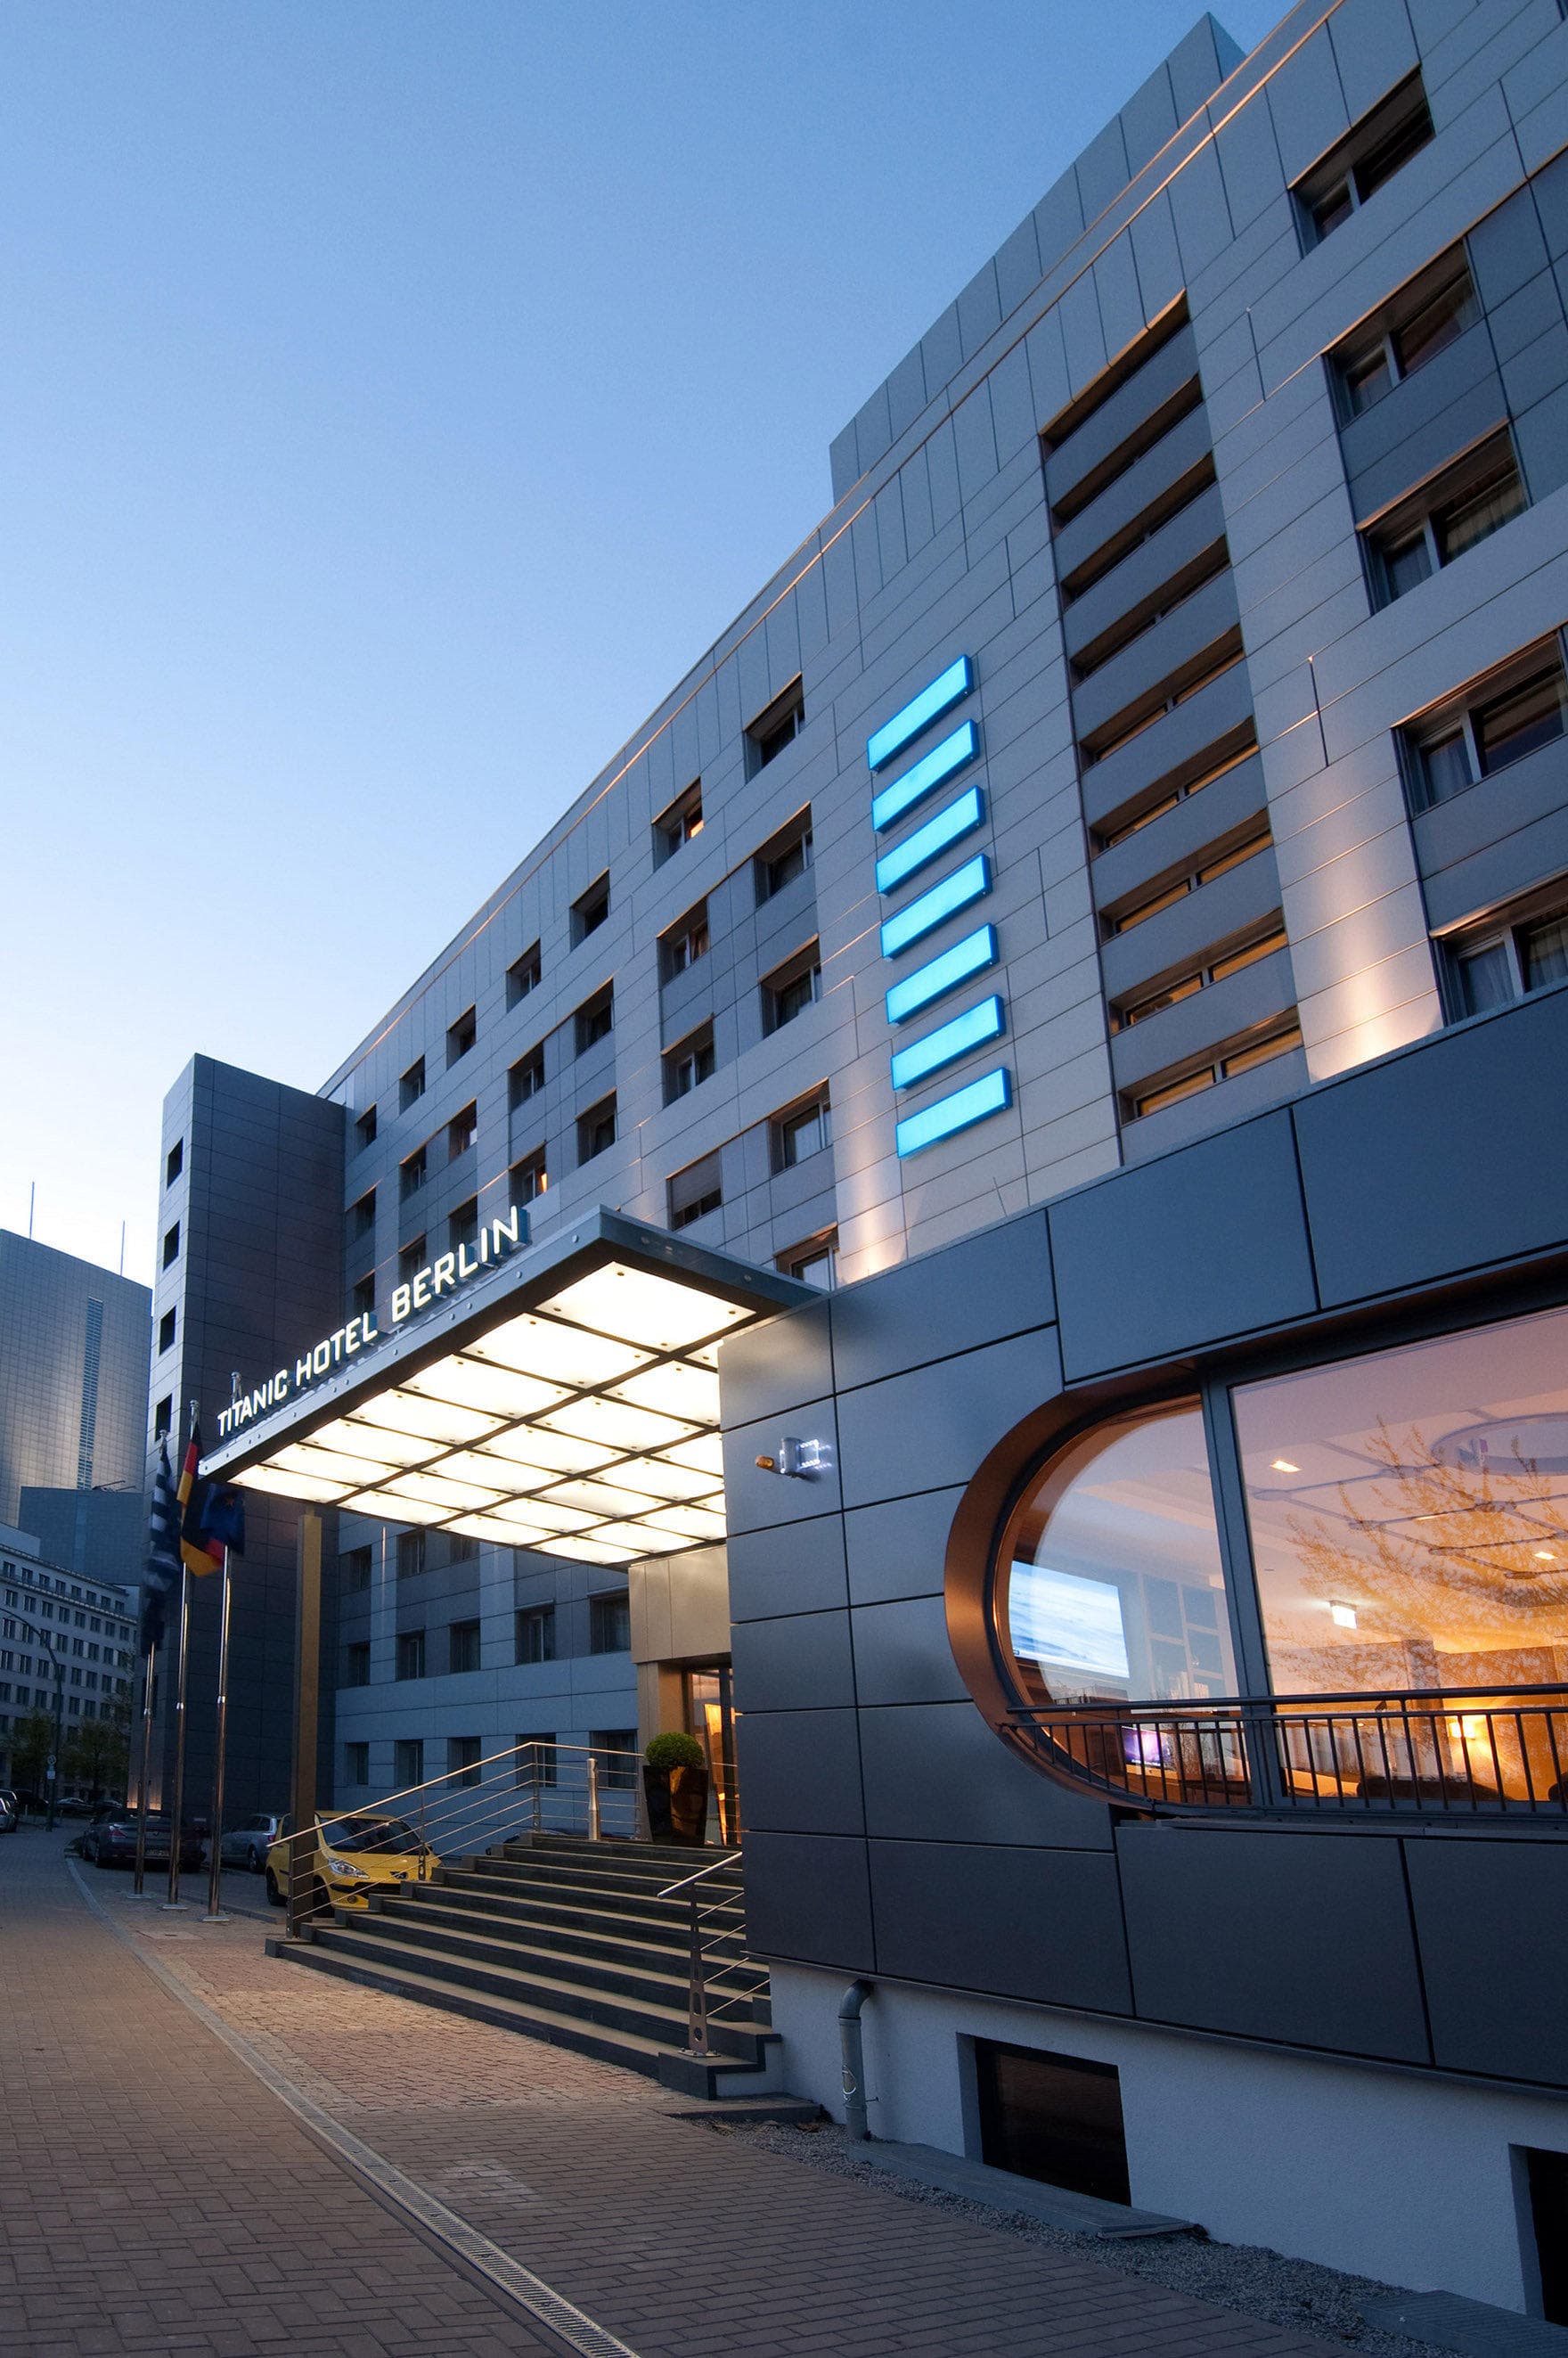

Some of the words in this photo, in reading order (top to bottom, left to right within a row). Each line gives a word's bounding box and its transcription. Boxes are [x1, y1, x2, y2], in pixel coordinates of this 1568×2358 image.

[217, 1369, 288, 1437] TITANIC
[296, 1312, 378, 1387] HOTEL
[392, 1205, 519, 1322] BERLIN
